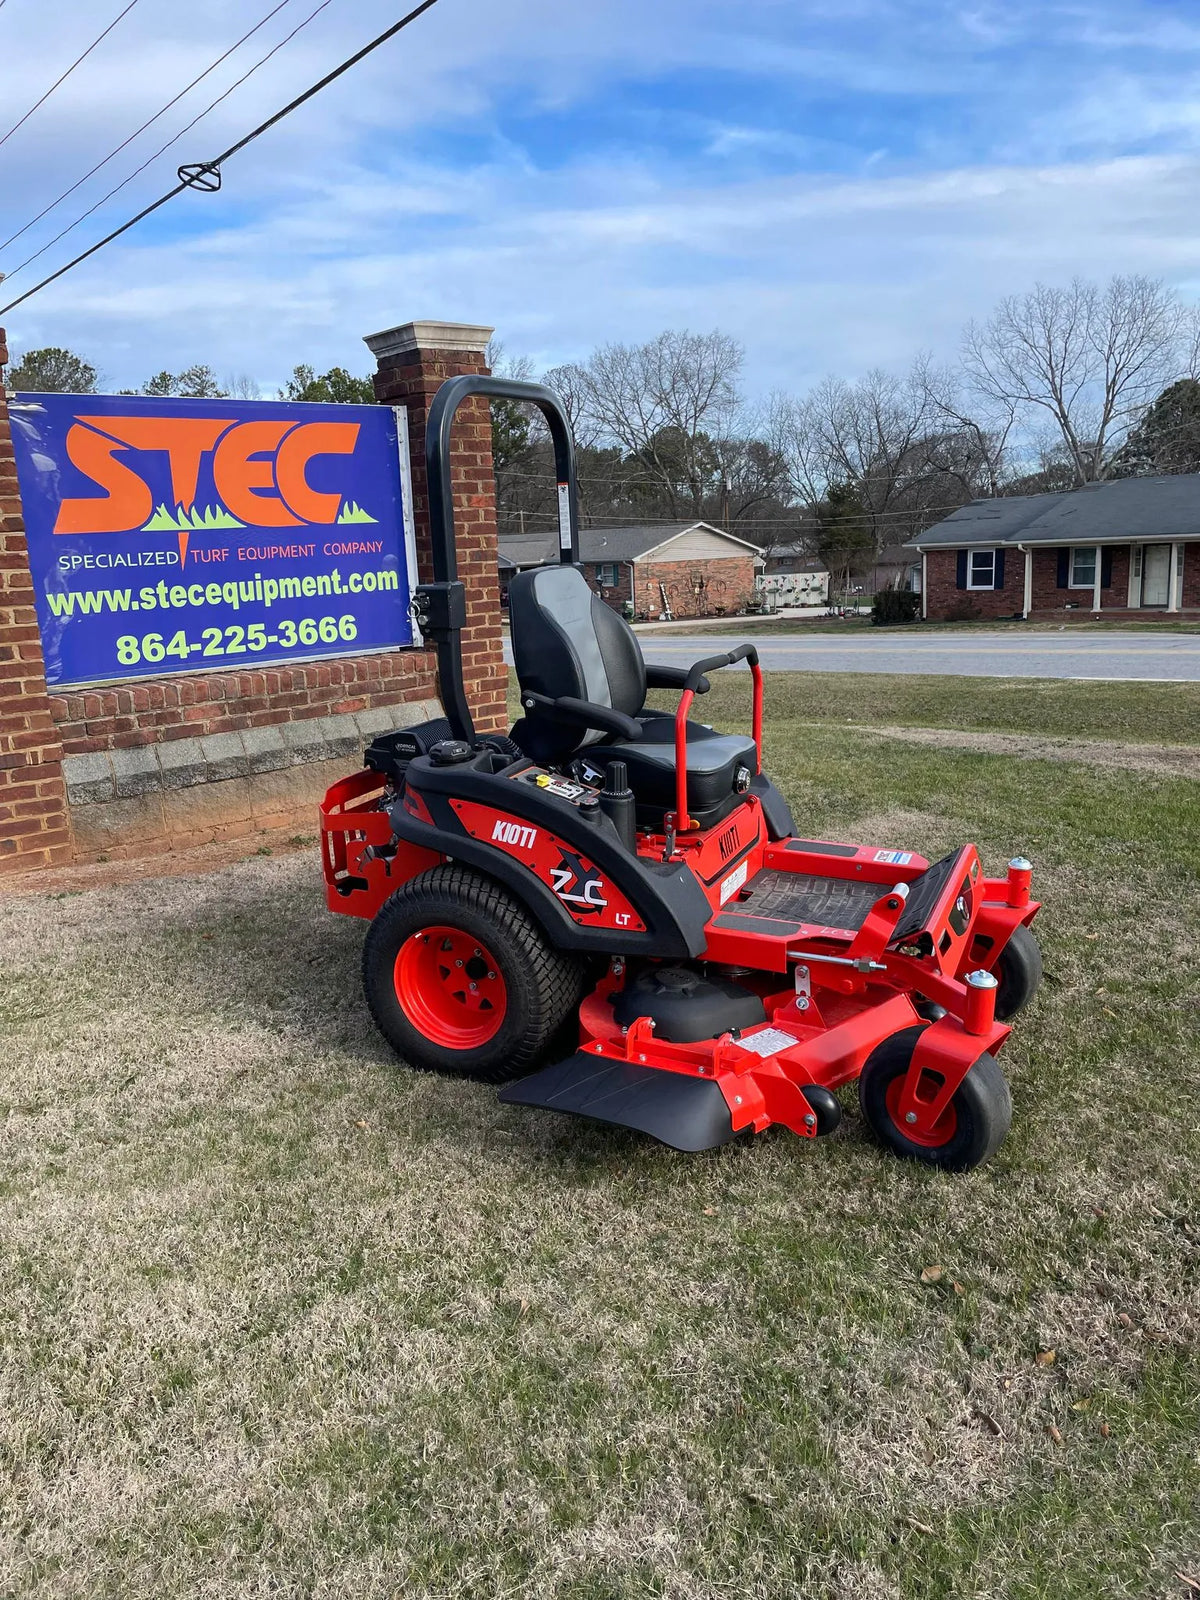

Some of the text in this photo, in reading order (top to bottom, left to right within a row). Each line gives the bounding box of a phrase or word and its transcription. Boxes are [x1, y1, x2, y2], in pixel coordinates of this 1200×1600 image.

[54, 415, 361, 535] STEC
[58, 541, 384, 570] SPECIALIZED TURF EQUIPMENT COMPANY
[46, 568, 398, 616] www.stecequipment.com
[116, 614, 358, 665] 864-225-3666
[491, 820, 537, 849] KIOTI
[719, 824, 740, 860] KIOTI
[615, 912, 631, 926] LT
